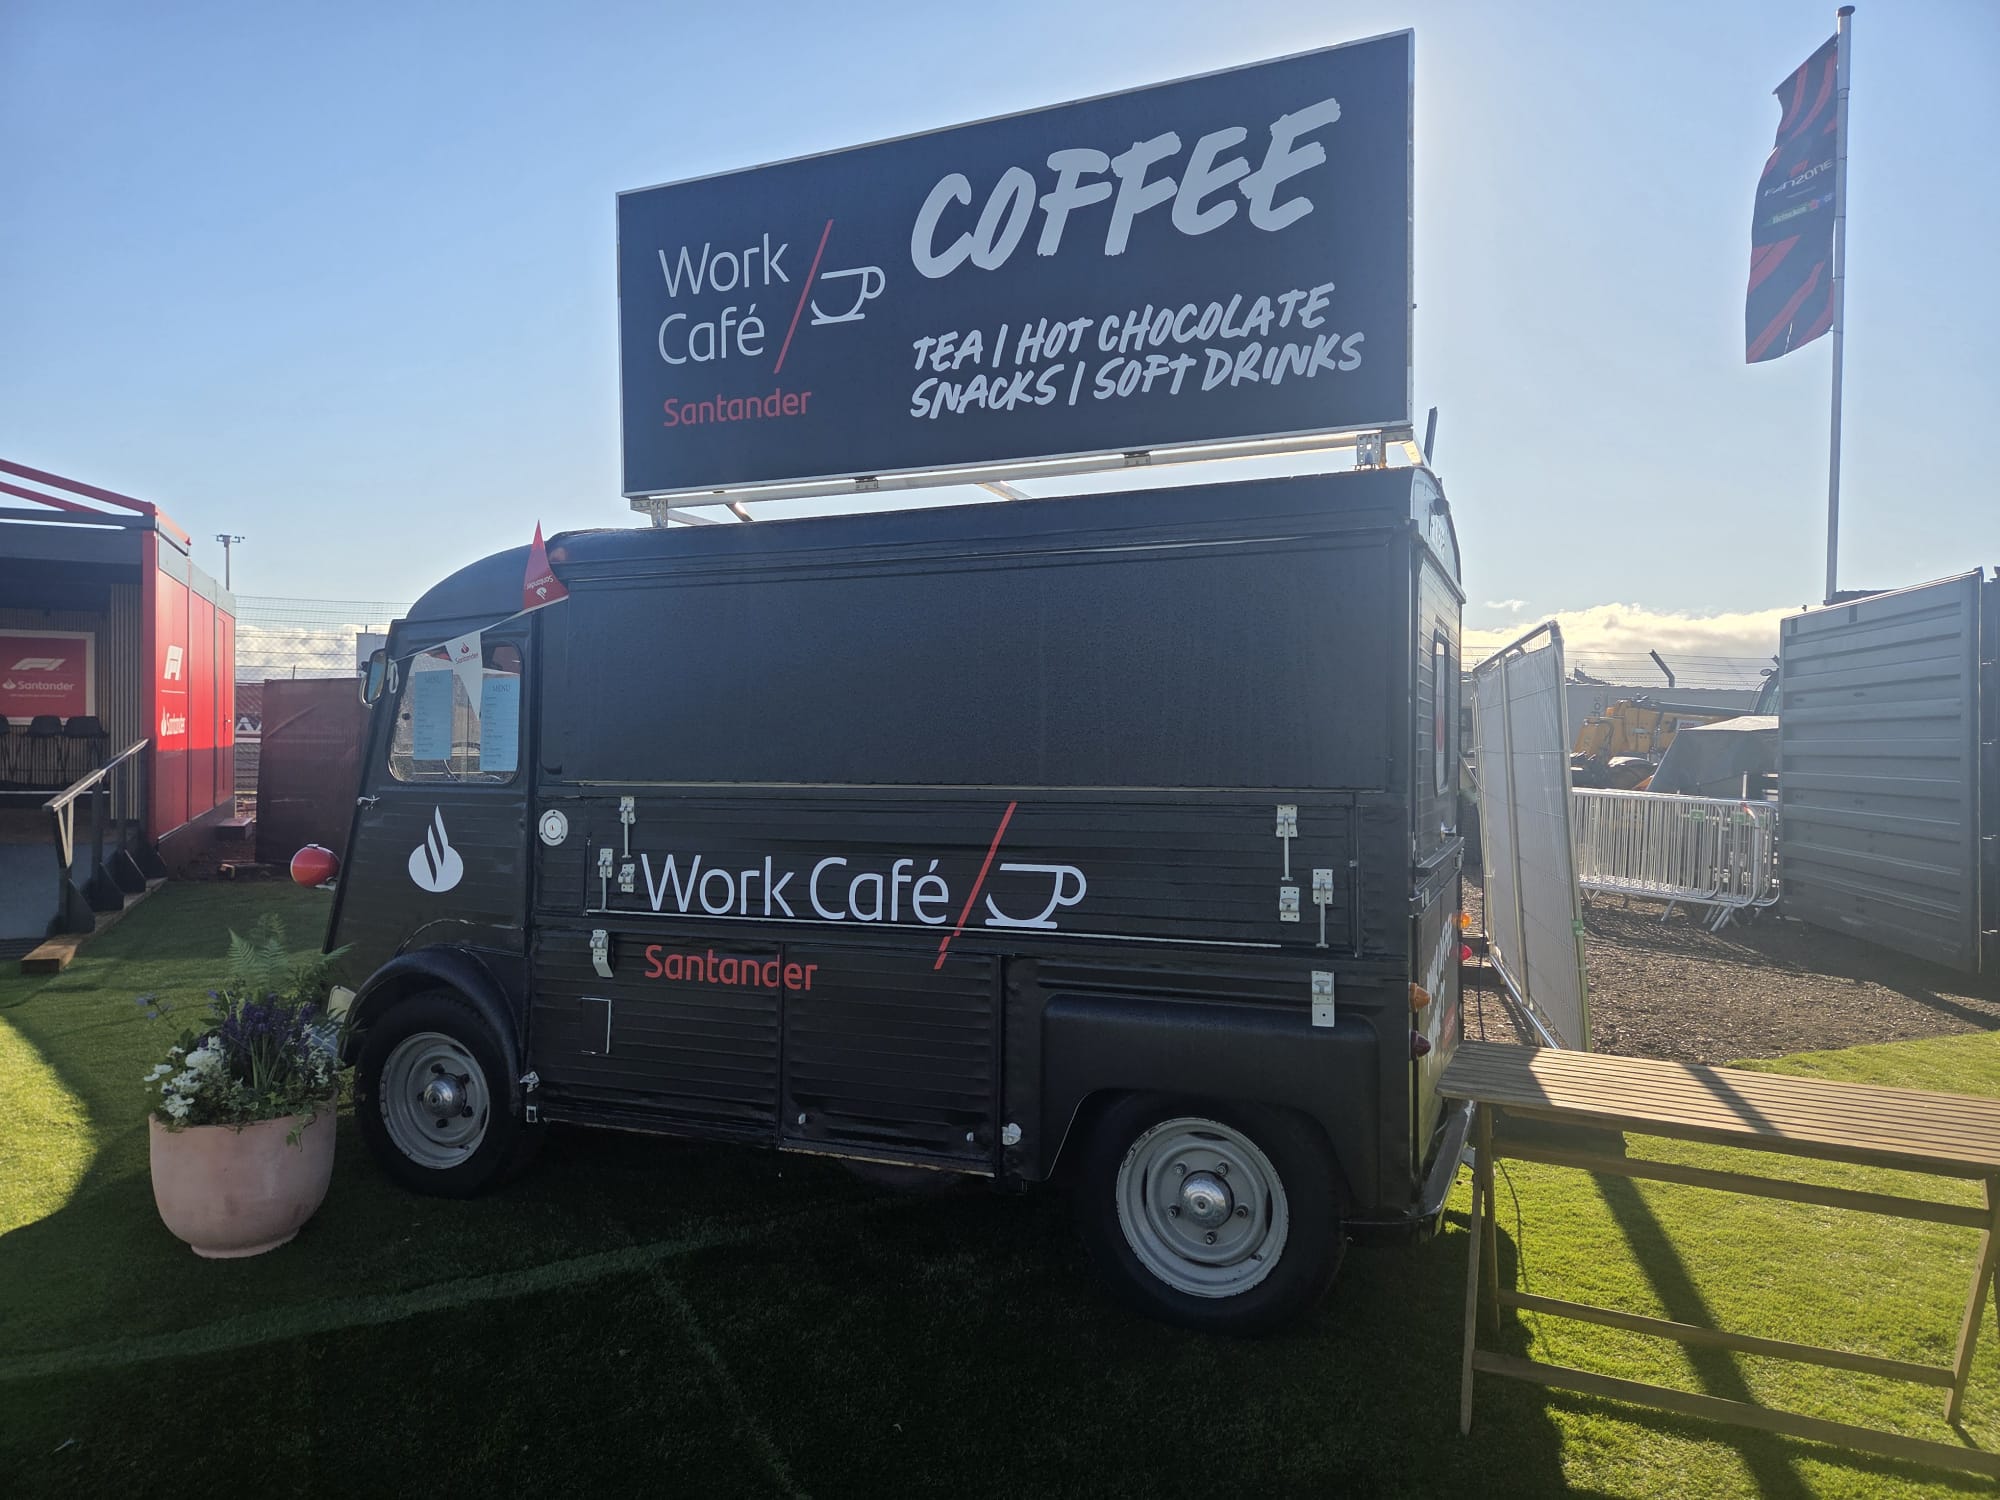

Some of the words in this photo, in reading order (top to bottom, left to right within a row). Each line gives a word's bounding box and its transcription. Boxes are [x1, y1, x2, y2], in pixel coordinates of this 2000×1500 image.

[911, 97, 1342, 280] COFFEE
[657, 231, 791, 299] Work
[657, 301, 766, 366] Café
[911, 328, 985, 373] TEA
[1014, 315, 1095, 366] HOT
[1097, 281, 1337, 355] CHOCOLATE
[663, 387, 812, 428] Santander
[909, 362, 1066, 421] SNACKS
[1092, 351, 1198, 401] SOFT
[1200, 330, 1366, 393] DRINKS
[17, 680, 76, 691] Santander
[640, 853, 796, 918] Work
[808, 856, 950, 925] Café
[644, 943, 819, 991] Santander
